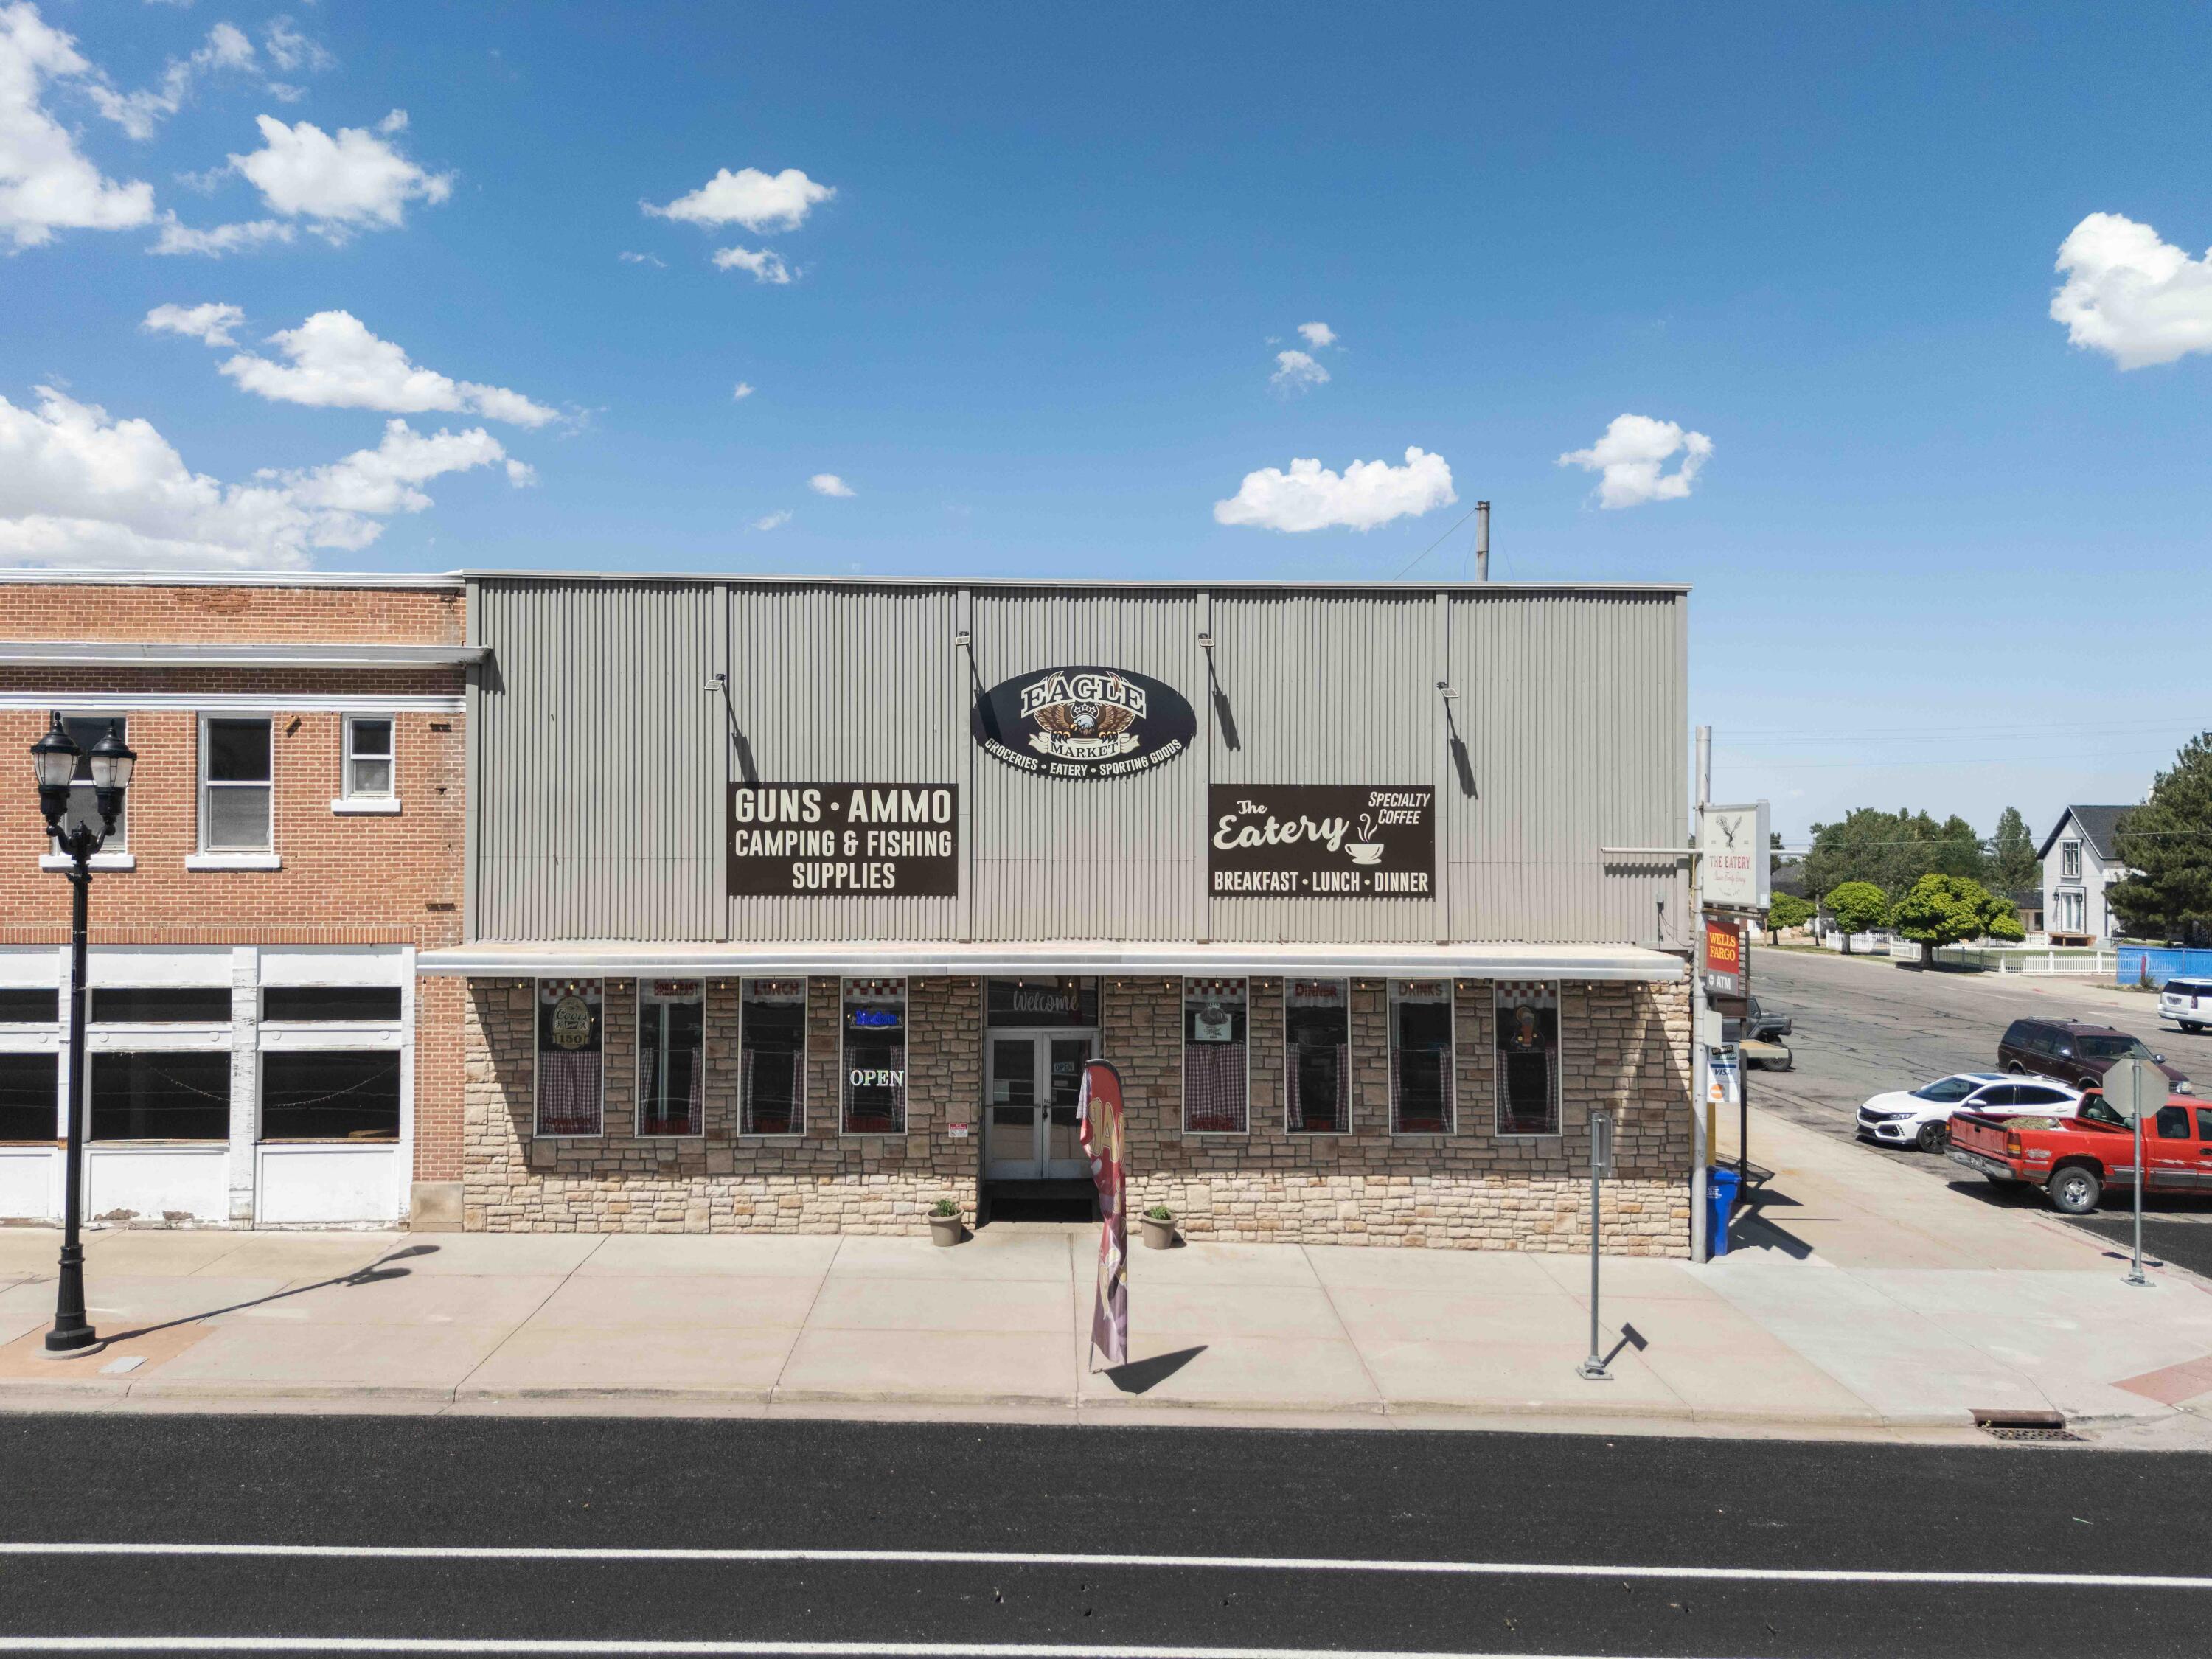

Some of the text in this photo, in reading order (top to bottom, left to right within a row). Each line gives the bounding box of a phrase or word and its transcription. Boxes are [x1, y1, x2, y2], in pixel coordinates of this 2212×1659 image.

[1021, 674, 1146, 719] EAGLE
[984, 737, 1182, 776] GROCERIES EATERY SPORTING GOODS
[1050, 742, 1119, 758] MARKET
[735, 788, 950, 824] GUNS AMMO
[1368, 791, 1430, 807] SPECIALTY
[1237, 800, 1267, 815] The
[1377, 809, 1421, 824] COFFEE
[1213, 815, 1349, 852] Eatery
[735, 830, 952, 857] CAMPING & FISHING
[1709, 855, 1750, 869] THE EATERY
[792, 862, 895, 888] SUPPLIES
[1214, 871, 1428, 892] BREAKFAST LUNCH DINNER
[1709, 932, 1736, 947] WELLS
[1709, 946, 1736, 961] FARGO
[1399, 982, 1442, 996] DRINKS
[1716, 975, 1731, 990] ATM
[1013, 990, 1079, 1012] Welcome
[557, 1008, 587, 1020] Coors
[559, 1034, 582, 1043] 150
[850, 1070, 904, 1087] OPEN
